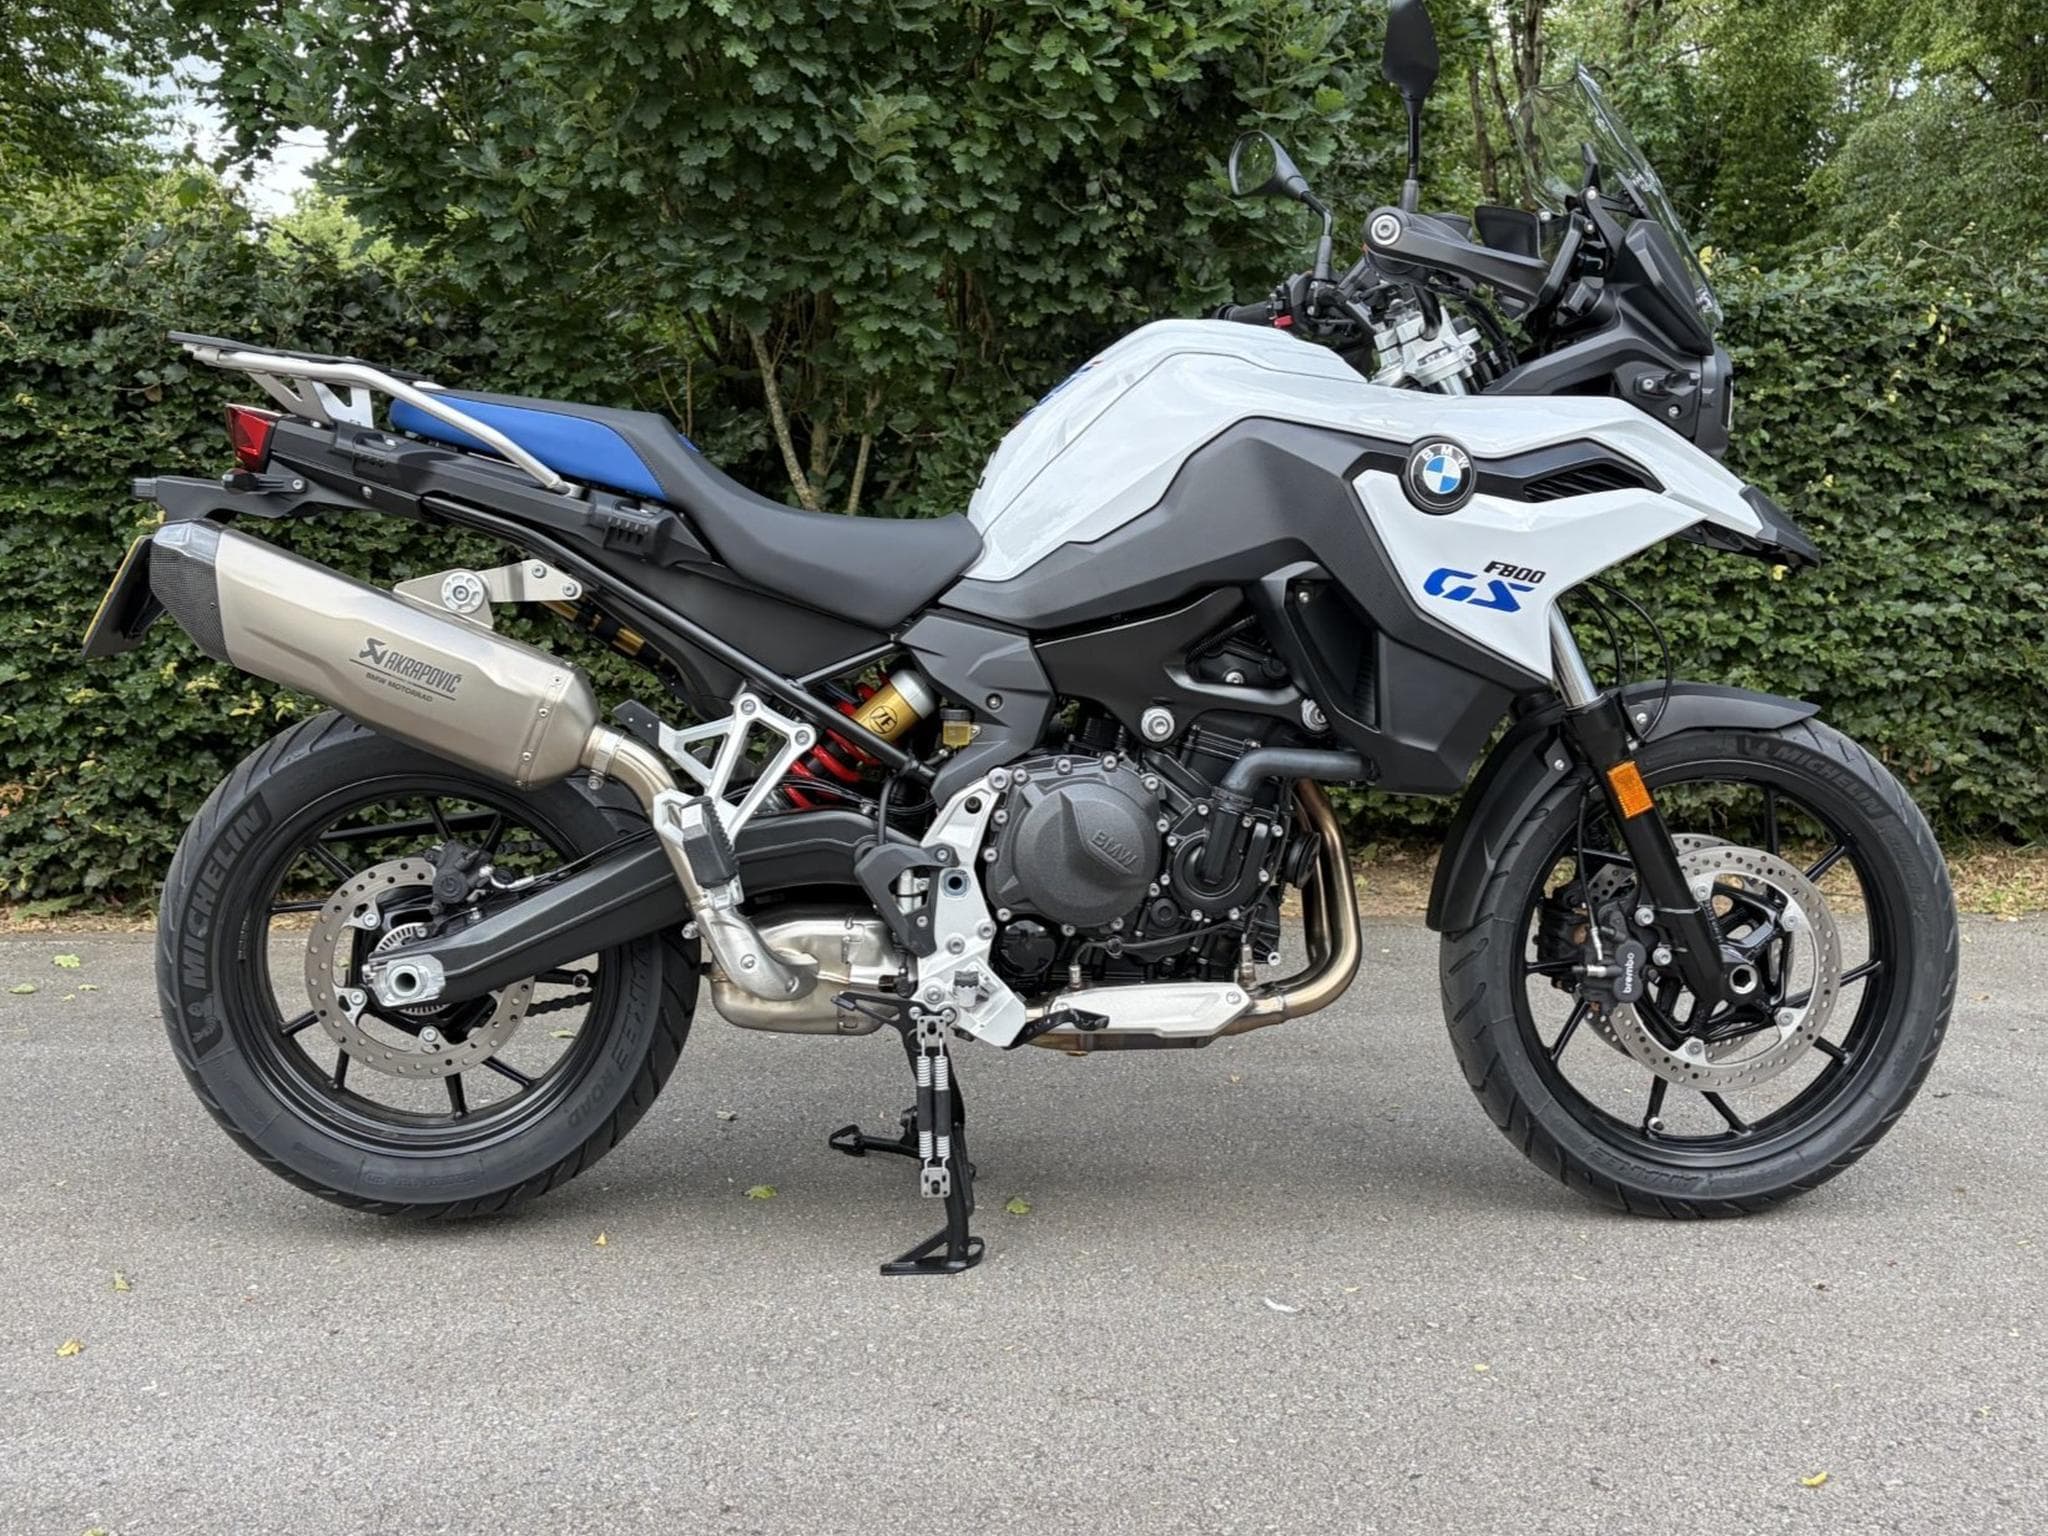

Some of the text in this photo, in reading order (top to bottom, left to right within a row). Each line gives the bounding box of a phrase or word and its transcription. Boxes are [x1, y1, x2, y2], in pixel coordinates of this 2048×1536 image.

[1421, 445, 1470, 469] BMW
[1423, 567, 1536, 613] GS
[1483, 560, 1547, 585] F800
[366, 672, 434, 702] BMW MOTORRAD
[870, 705, 898, 734] ZF
[1773, 748, 1886, 816] MICHELIN
[1092, 829, 1138, 867] BMW
[183, 801, 264, 990] MICHELIN
[1622, 952, 1636, 993] brembo
